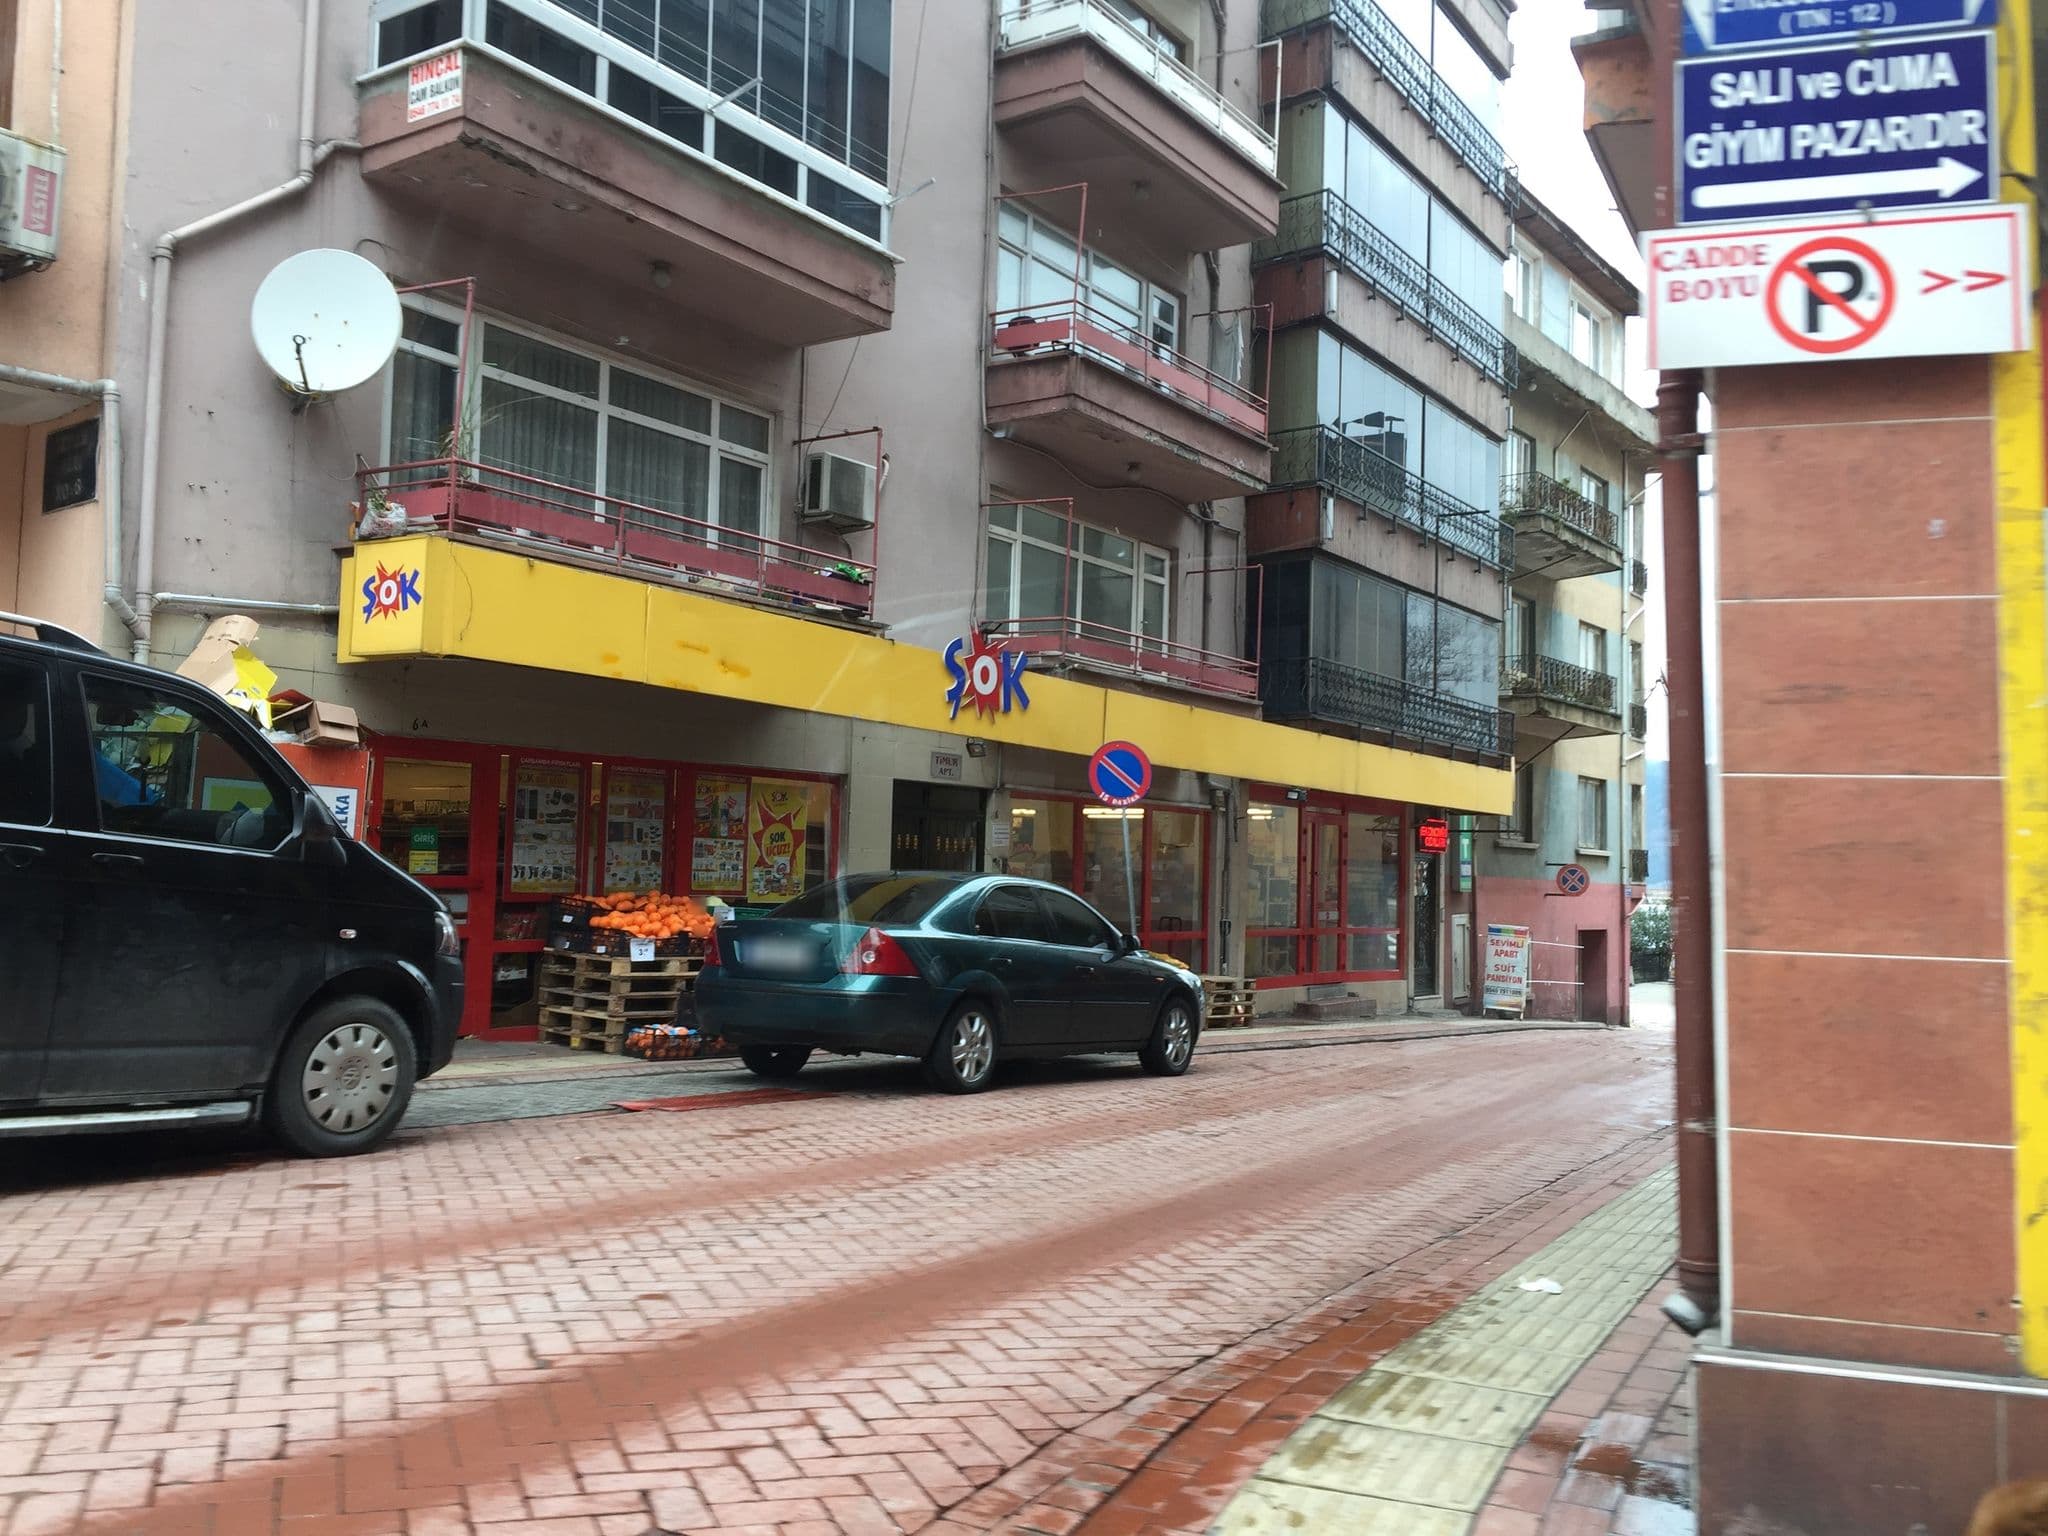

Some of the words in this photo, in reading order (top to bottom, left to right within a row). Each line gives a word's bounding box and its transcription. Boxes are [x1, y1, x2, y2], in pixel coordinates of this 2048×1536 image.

[1710, 67, 1793, 108] SALI
[1797, 71, 1841, 99] ve
[1845, 52, 1960, 96] CUMA
[1685, 120, 1785, 169] GİYİM
[1791, 109, 1987, 160] PAZARIDIR
[1656, 244, 1770, 273] CADDE
[1667, 276, 1760, 303] BOYU
[362, 568, 422, 624] ŞOK
[943, 636, 1030, 720] ŞOK
